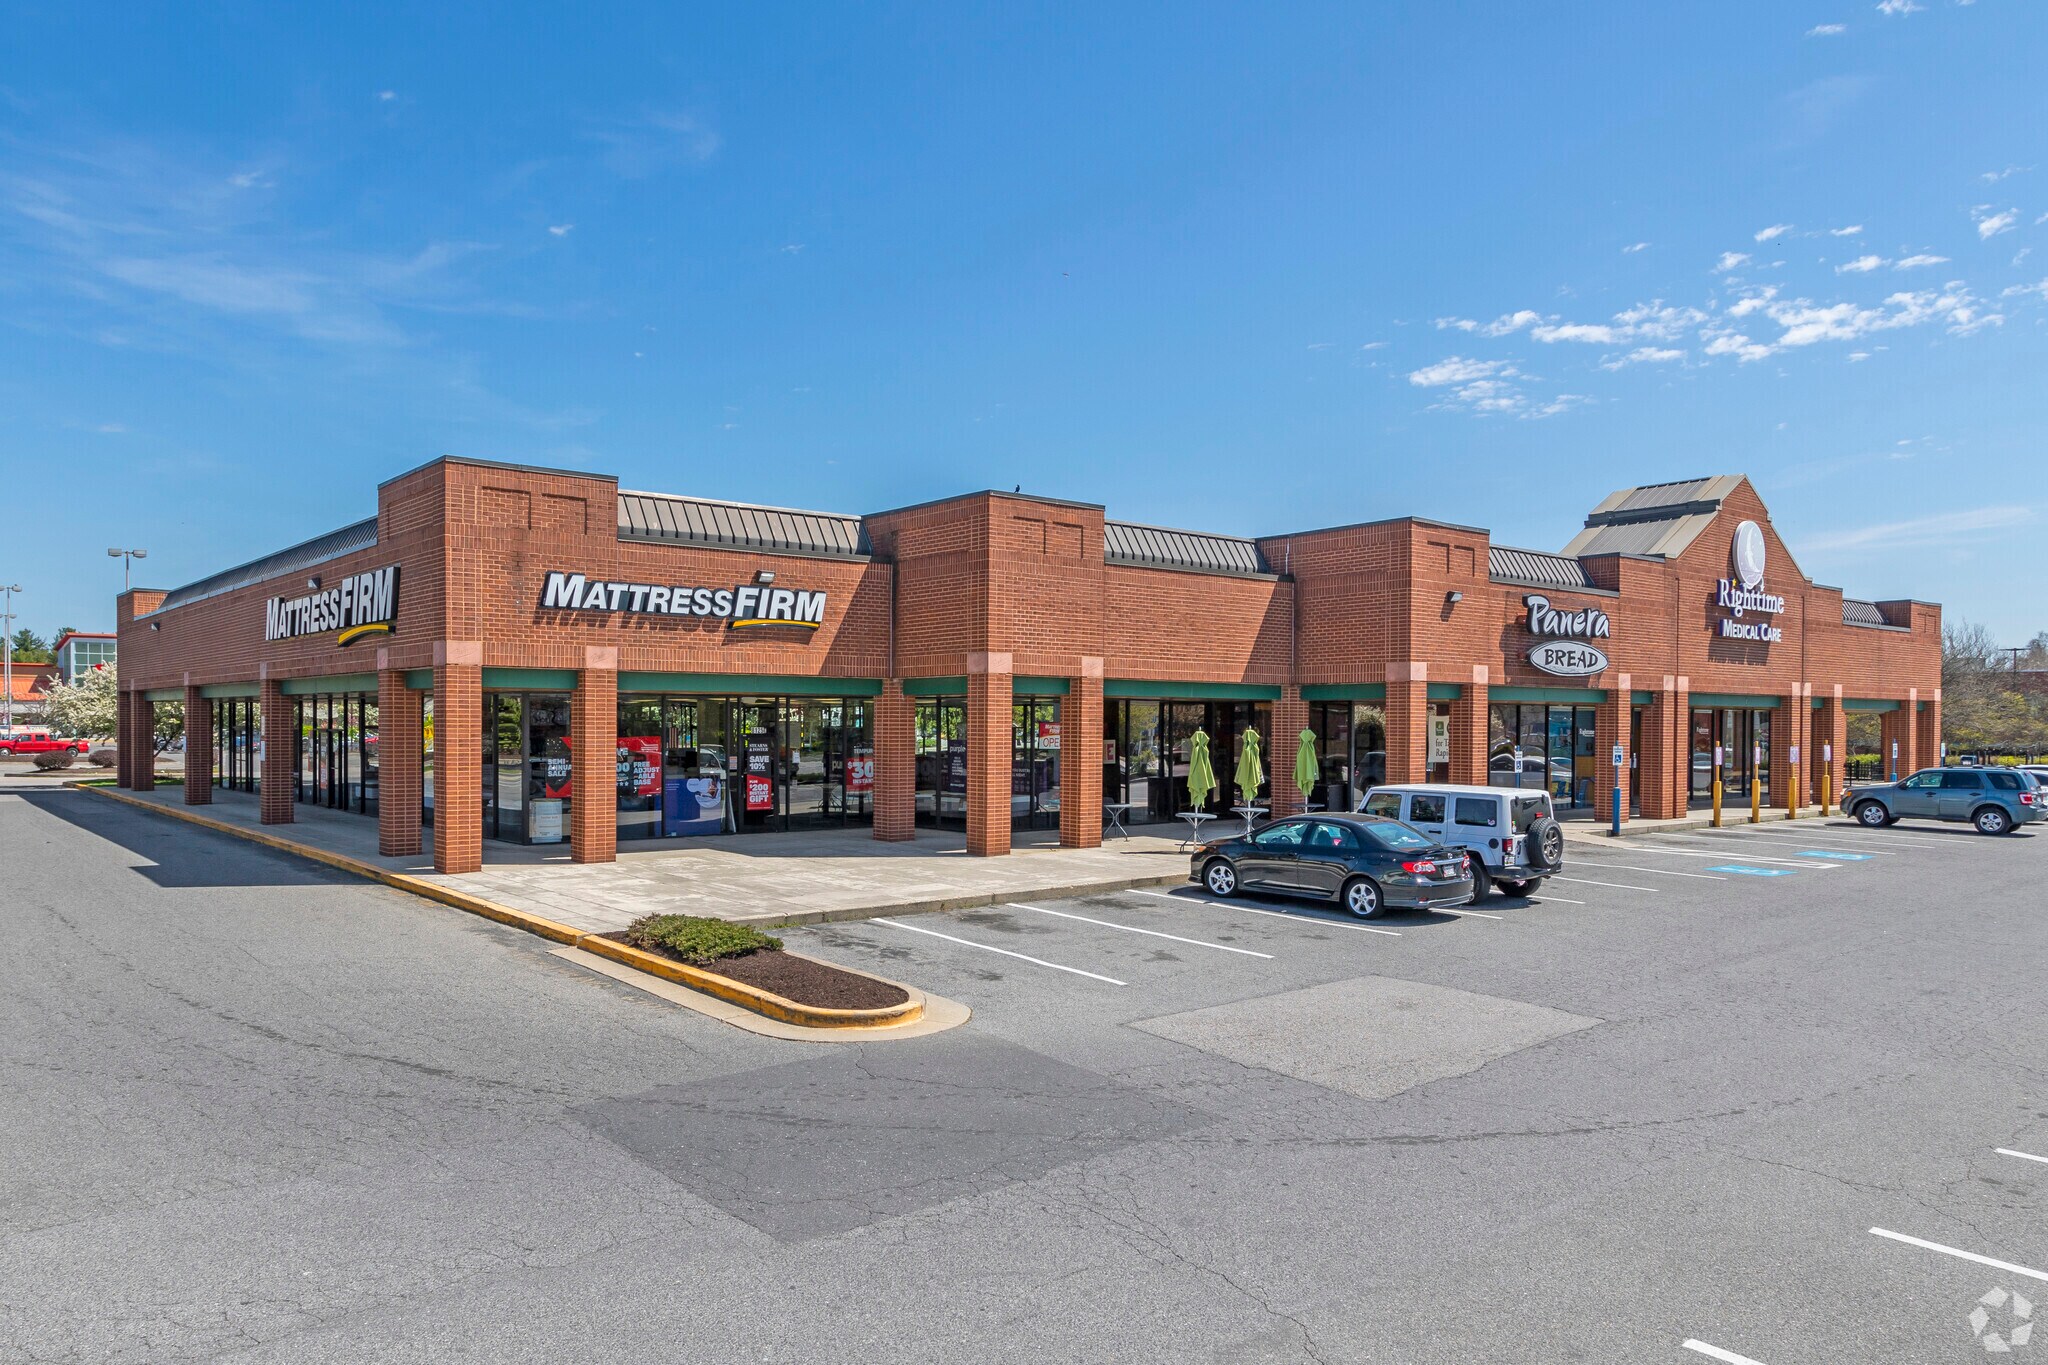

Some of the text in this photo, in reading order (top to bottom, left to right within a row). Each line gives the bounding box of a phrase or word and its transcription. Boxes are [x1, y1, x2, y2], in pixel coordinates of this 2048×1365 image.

[1718, 578, 1785, 617] Righttime
[1525, 595, 1610, 638] Panera
[1722, 618, 1782, 643] MEDICAL CARE
[1544, 648, 1598, 669] BREAD
[1043, 737, 1060, 748] OPE
[749, 755, 770, 763] SAVE
[1435, 748, 1449, 759] Rapi
[633, 766, 660, 774] ADJUST
[749, 762, 765, 770] 10%
[847, 761, 874, 779] $30
[749, 783, 769, 791] $200
[749, 795, 769, 803] GIFT
